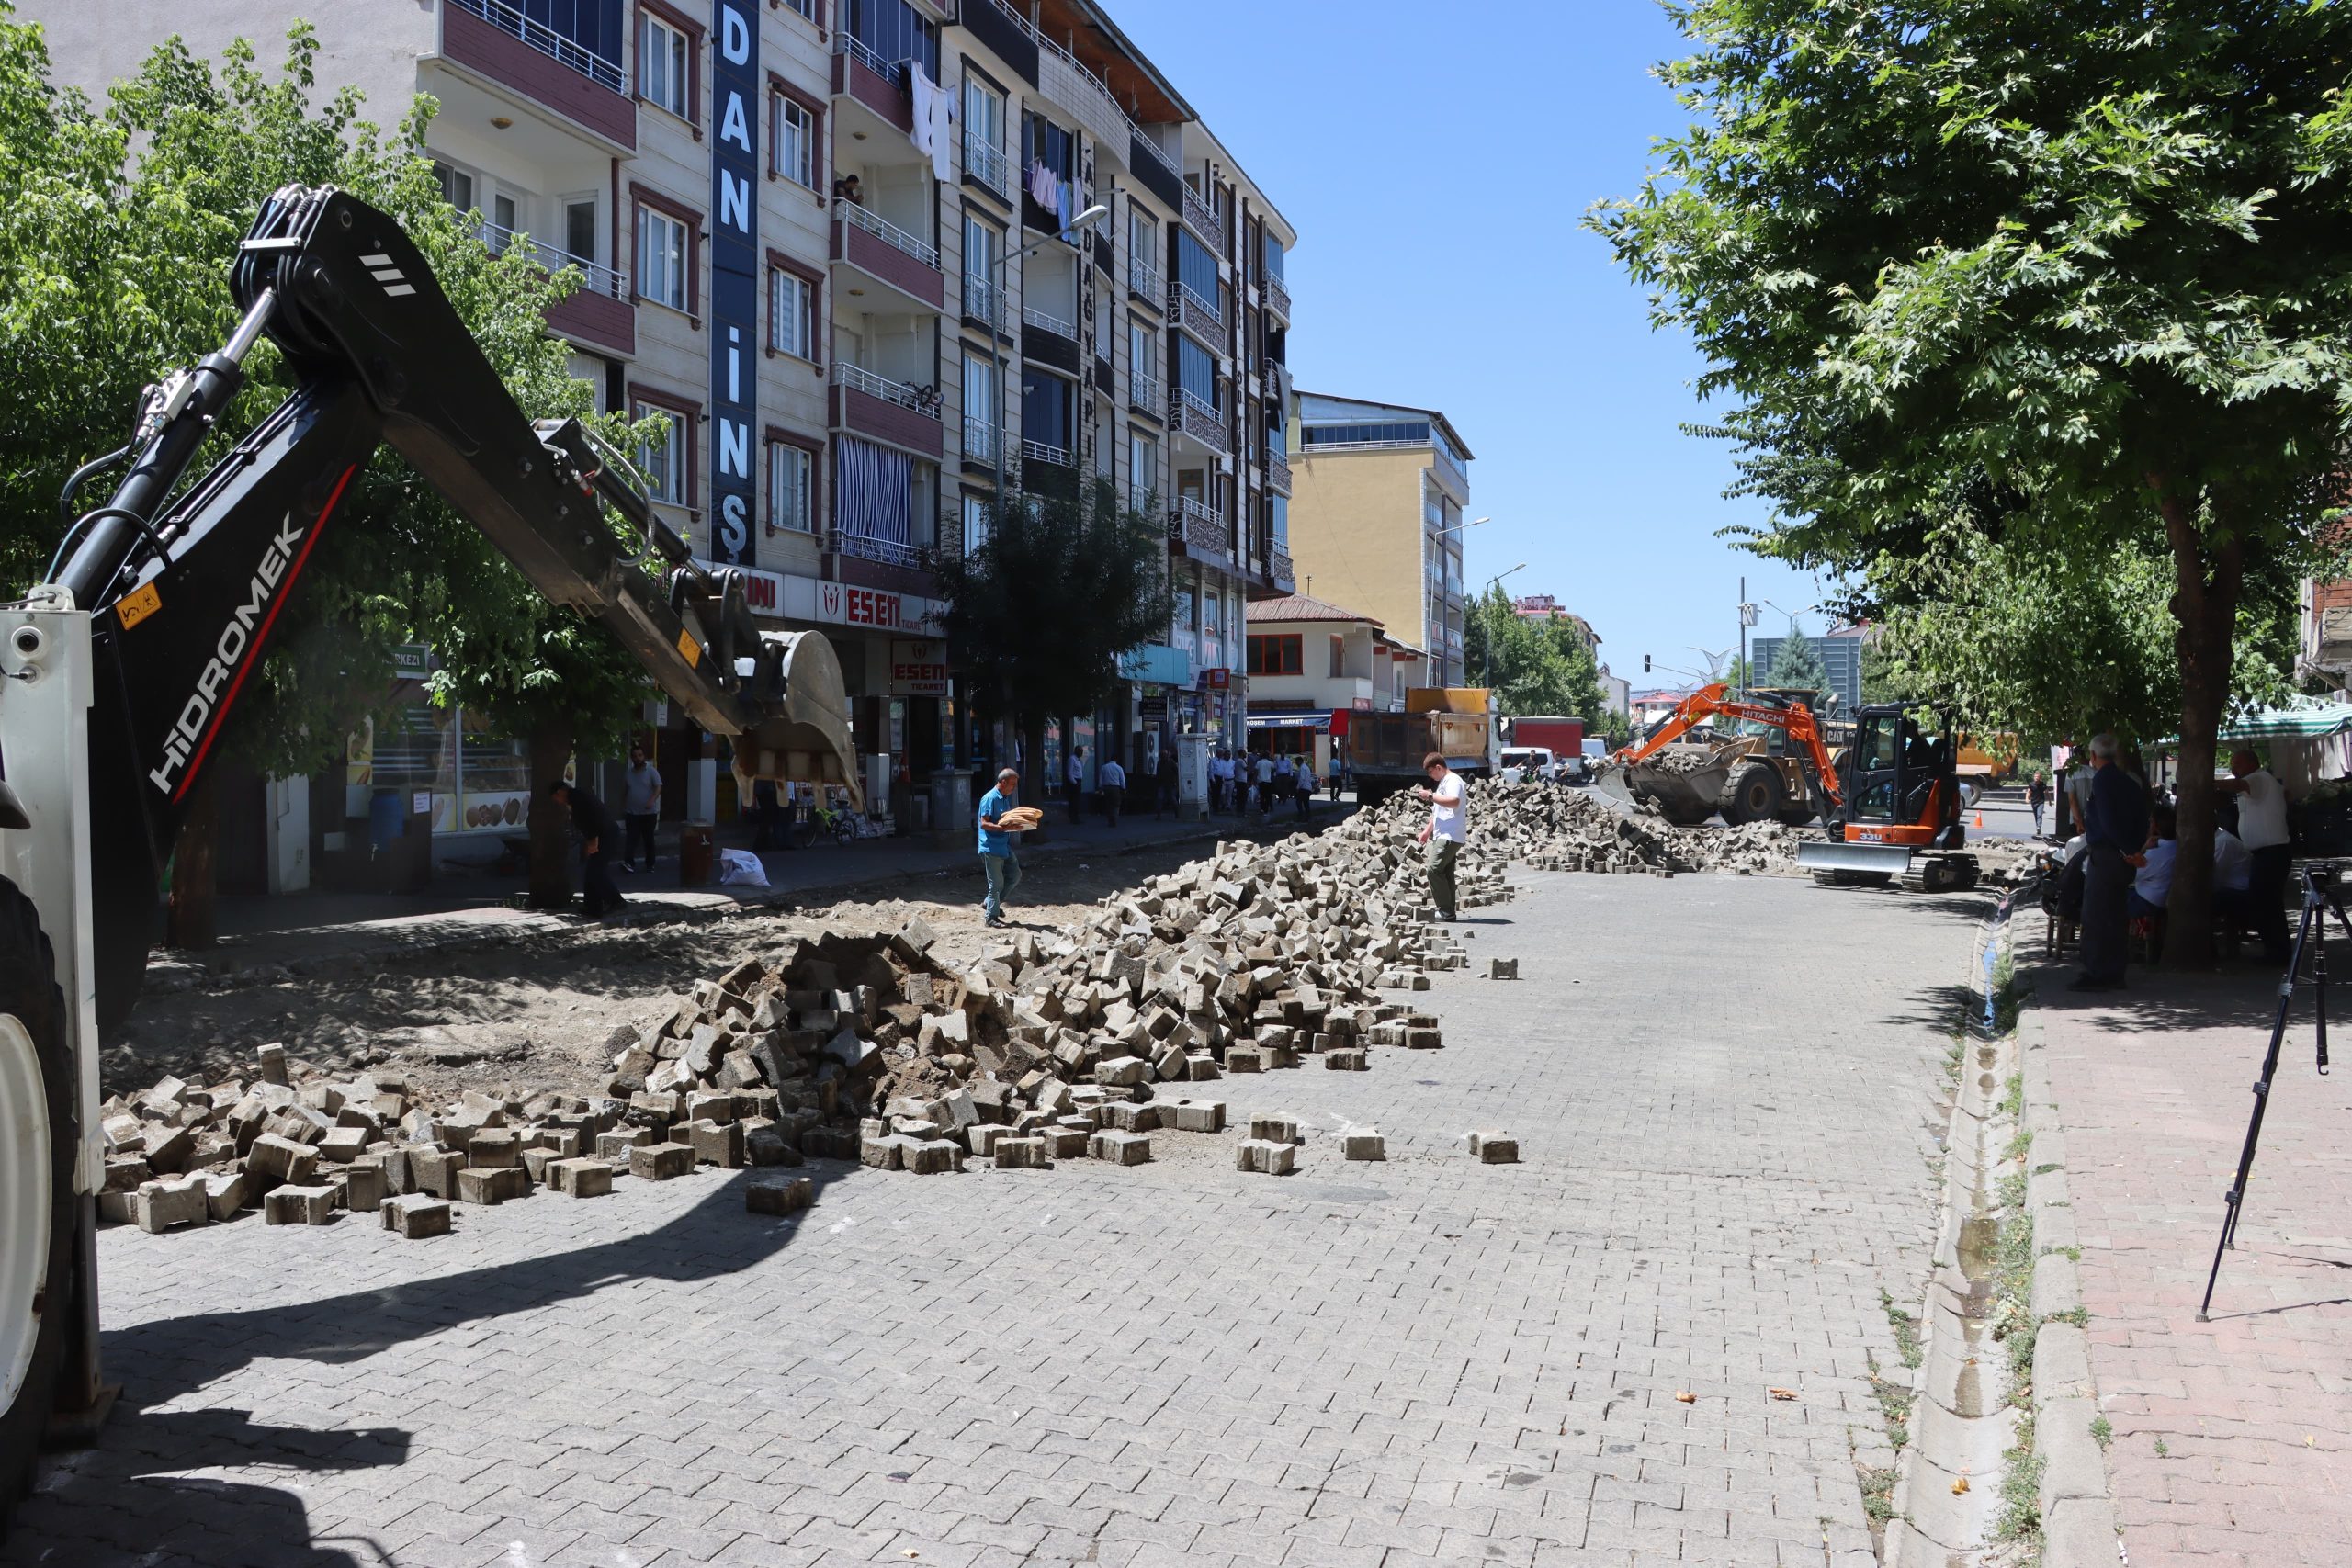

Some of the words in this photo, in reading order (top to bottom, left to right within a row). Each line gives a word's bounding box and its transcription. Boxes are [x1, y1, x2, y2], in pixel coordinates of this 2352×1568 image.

[720, 3, 752, 235] DAN
[719, 326, 749, 564] İNŞ
[847, 589, 900, 627] ESEN
[894, 663, 945, 680] ESEN
[1741, 708, 1785, 724] HITACHI
[1826, 729, 1844, 743] CAT
[1860, 832, 1883, 841] 33U
